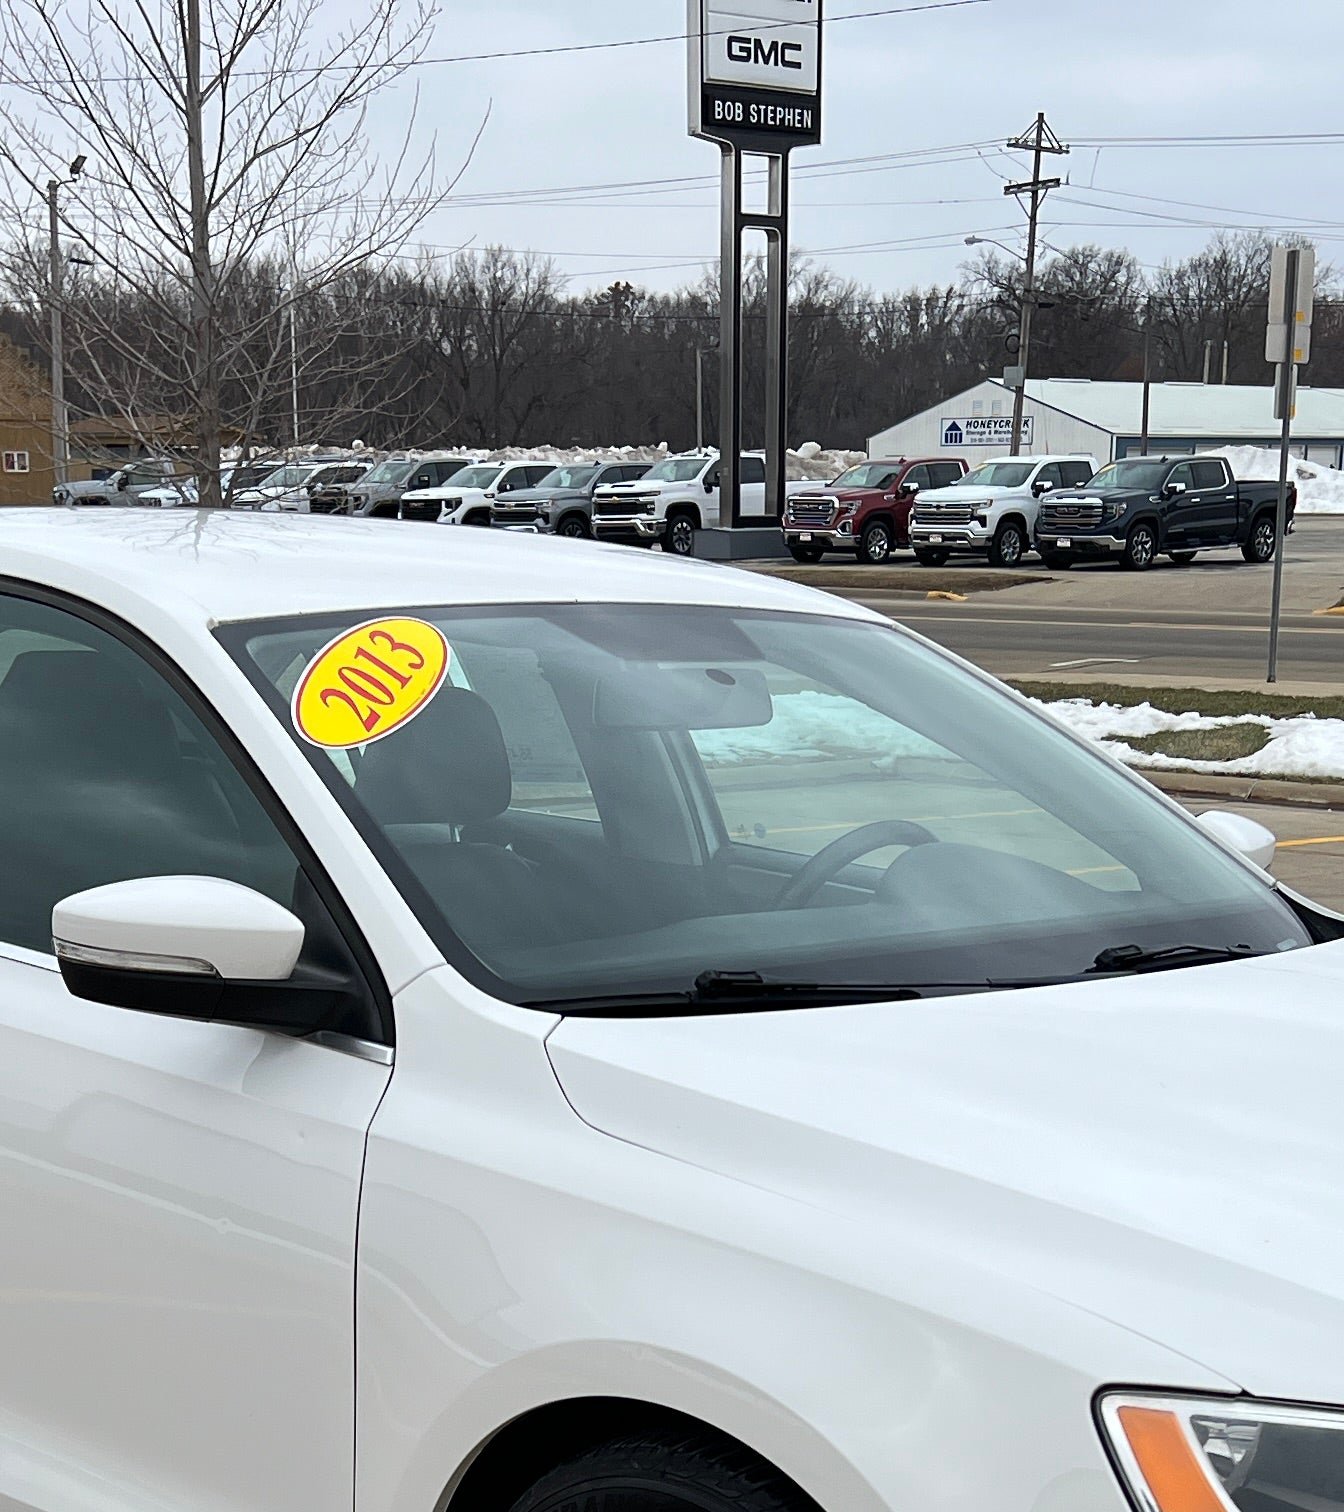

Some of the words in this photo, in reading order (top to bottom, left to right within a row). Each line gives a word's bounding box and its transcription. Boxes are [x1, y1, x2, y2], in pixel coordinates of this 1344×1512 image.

[727, 35, 802, 70] GMC
[714, 100, 744, 121] BOB
[749, 103, 812, 129] STEPHEN
[965, 419, 1029, 429] HONEYCRK
[319, 630, 425, 733] 2013
